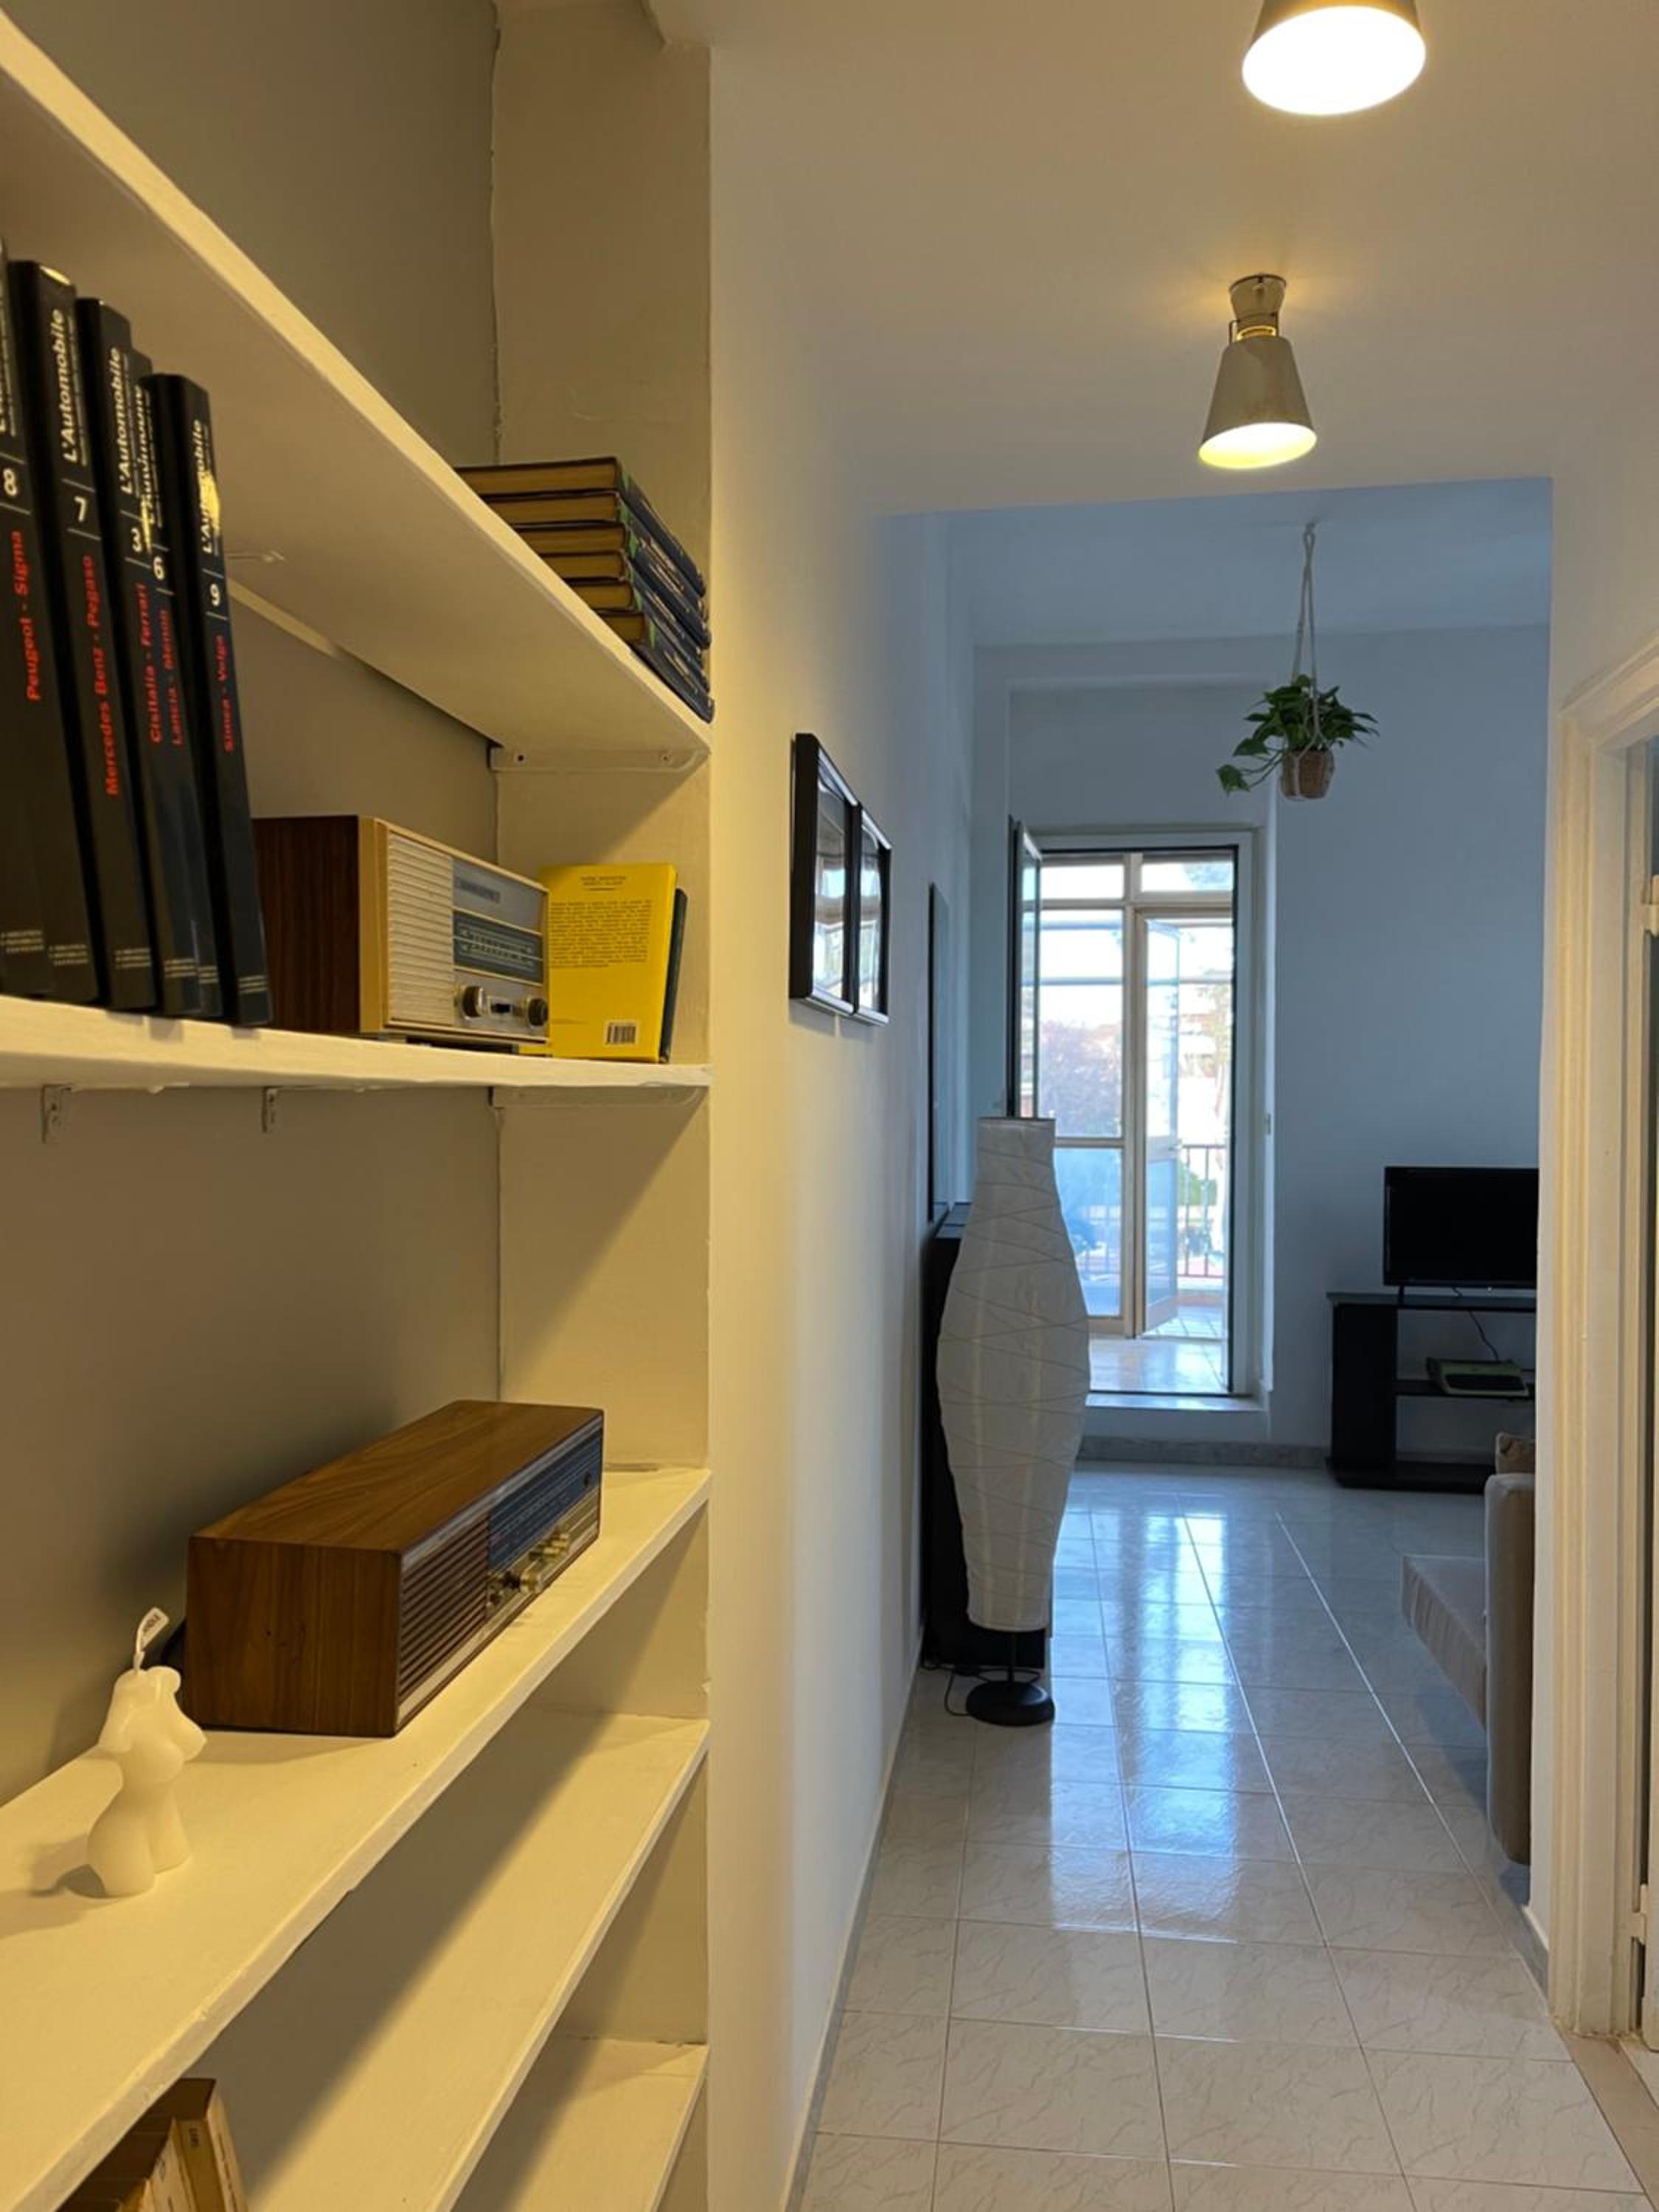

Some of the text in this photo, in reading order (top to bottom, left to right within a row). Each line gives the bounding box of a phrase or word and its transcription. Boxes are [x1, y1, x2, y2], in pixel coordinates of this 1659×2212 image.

[51, 309, 77, 462] L'Automobile
[110, 347, 133, 495] L'Automobile
[3, 468, 18, 496] 8
[74, 495, 87, 522] 7
[12, 531, 28, 595] Sigma
[131, 527, 142, 552] 3
[153, 557, 164, 580] 6
[82, 556, 99, 627] Pegaso
[136, 583, 151, 646] Ferrari
[209, 583, 220, 607] 9
[20, 618, 40, 700] Peugeot
[94, 648, 108, 694] Benz
[100, 702, 118, 796] Mercedes
